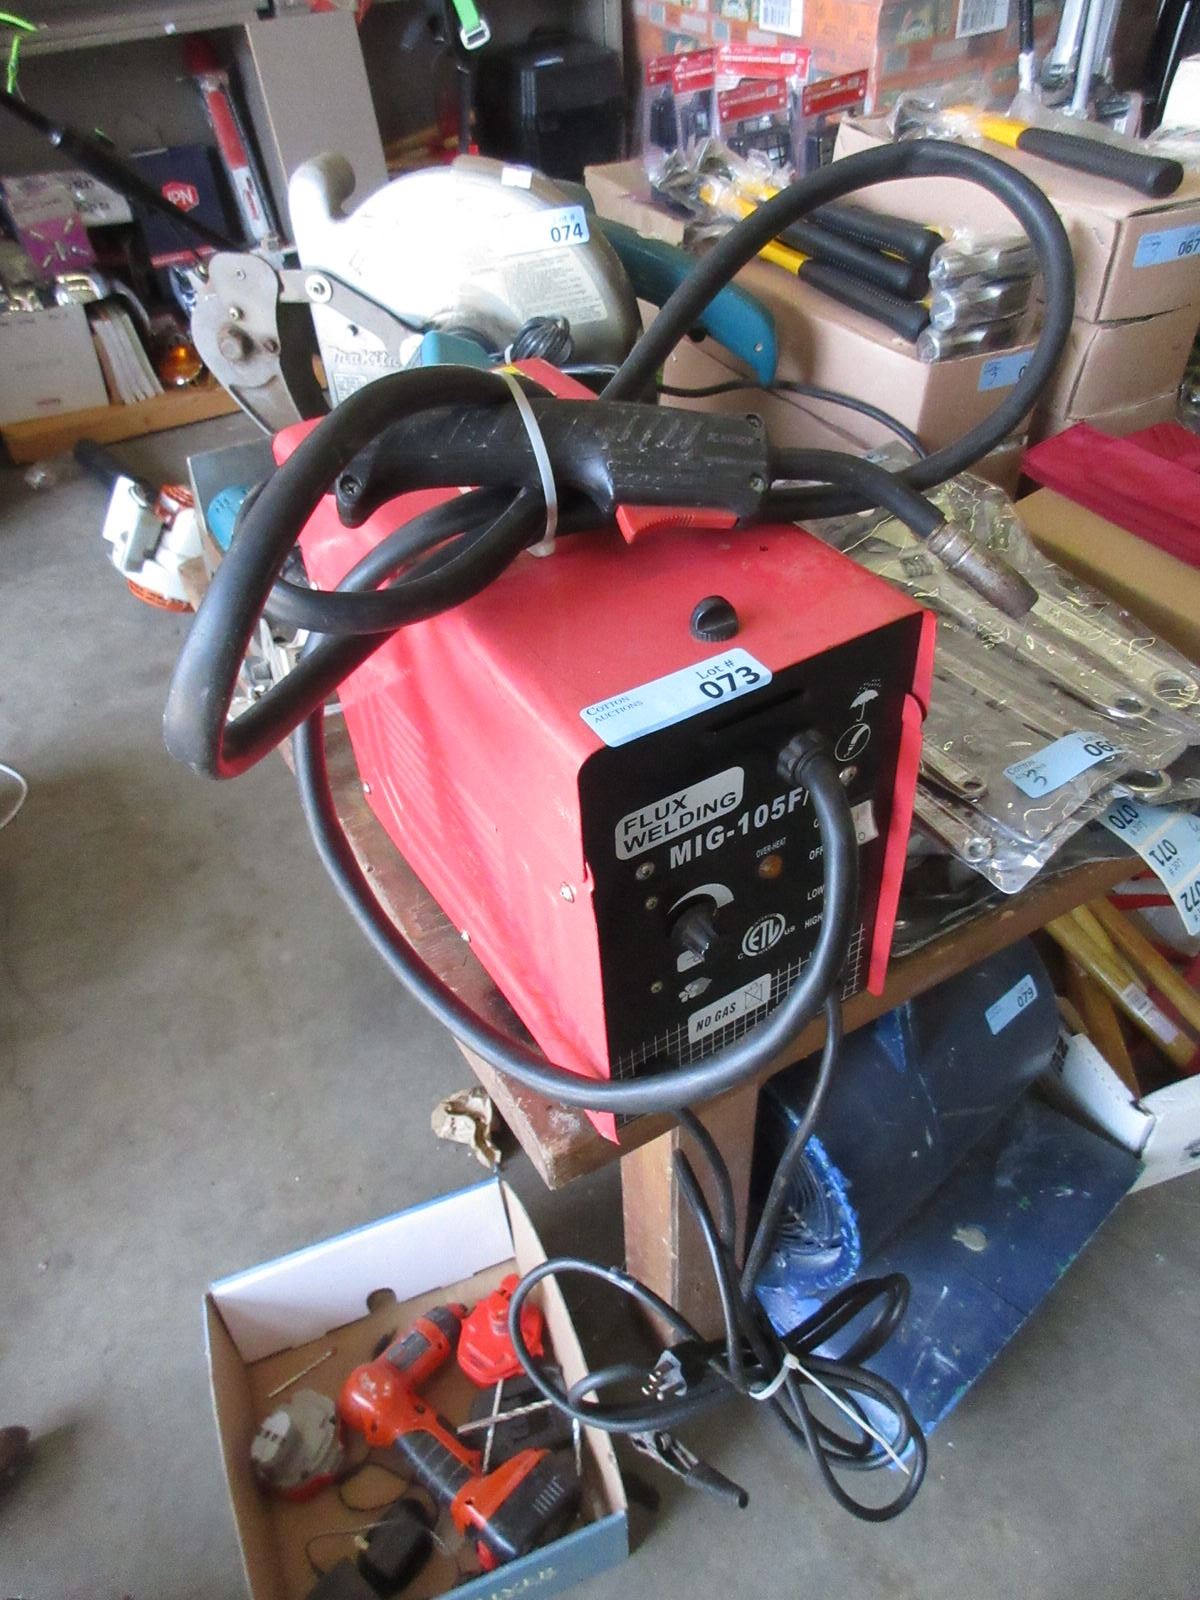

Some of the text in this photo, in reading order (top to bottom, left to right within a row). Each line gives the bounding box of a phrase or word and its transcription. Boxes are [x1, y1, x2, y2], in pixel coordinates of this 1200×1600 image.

[550, 222, 584, 243] 074
[695, 658, 735, 680] Lot #
[699, 665, 760, 699] 073
[622, 791, 737, 853] WELDING
[624, 794, 688, 836] FLUX
[1107, 804, 1139, 830] 070
[755, 836, 787, 859] OVER-HEAT
[1148, 839, 1178, 867] 071
[1017, 986, 1034, 1008] 079
[695, 1002, 737, 1033] NO GAS
